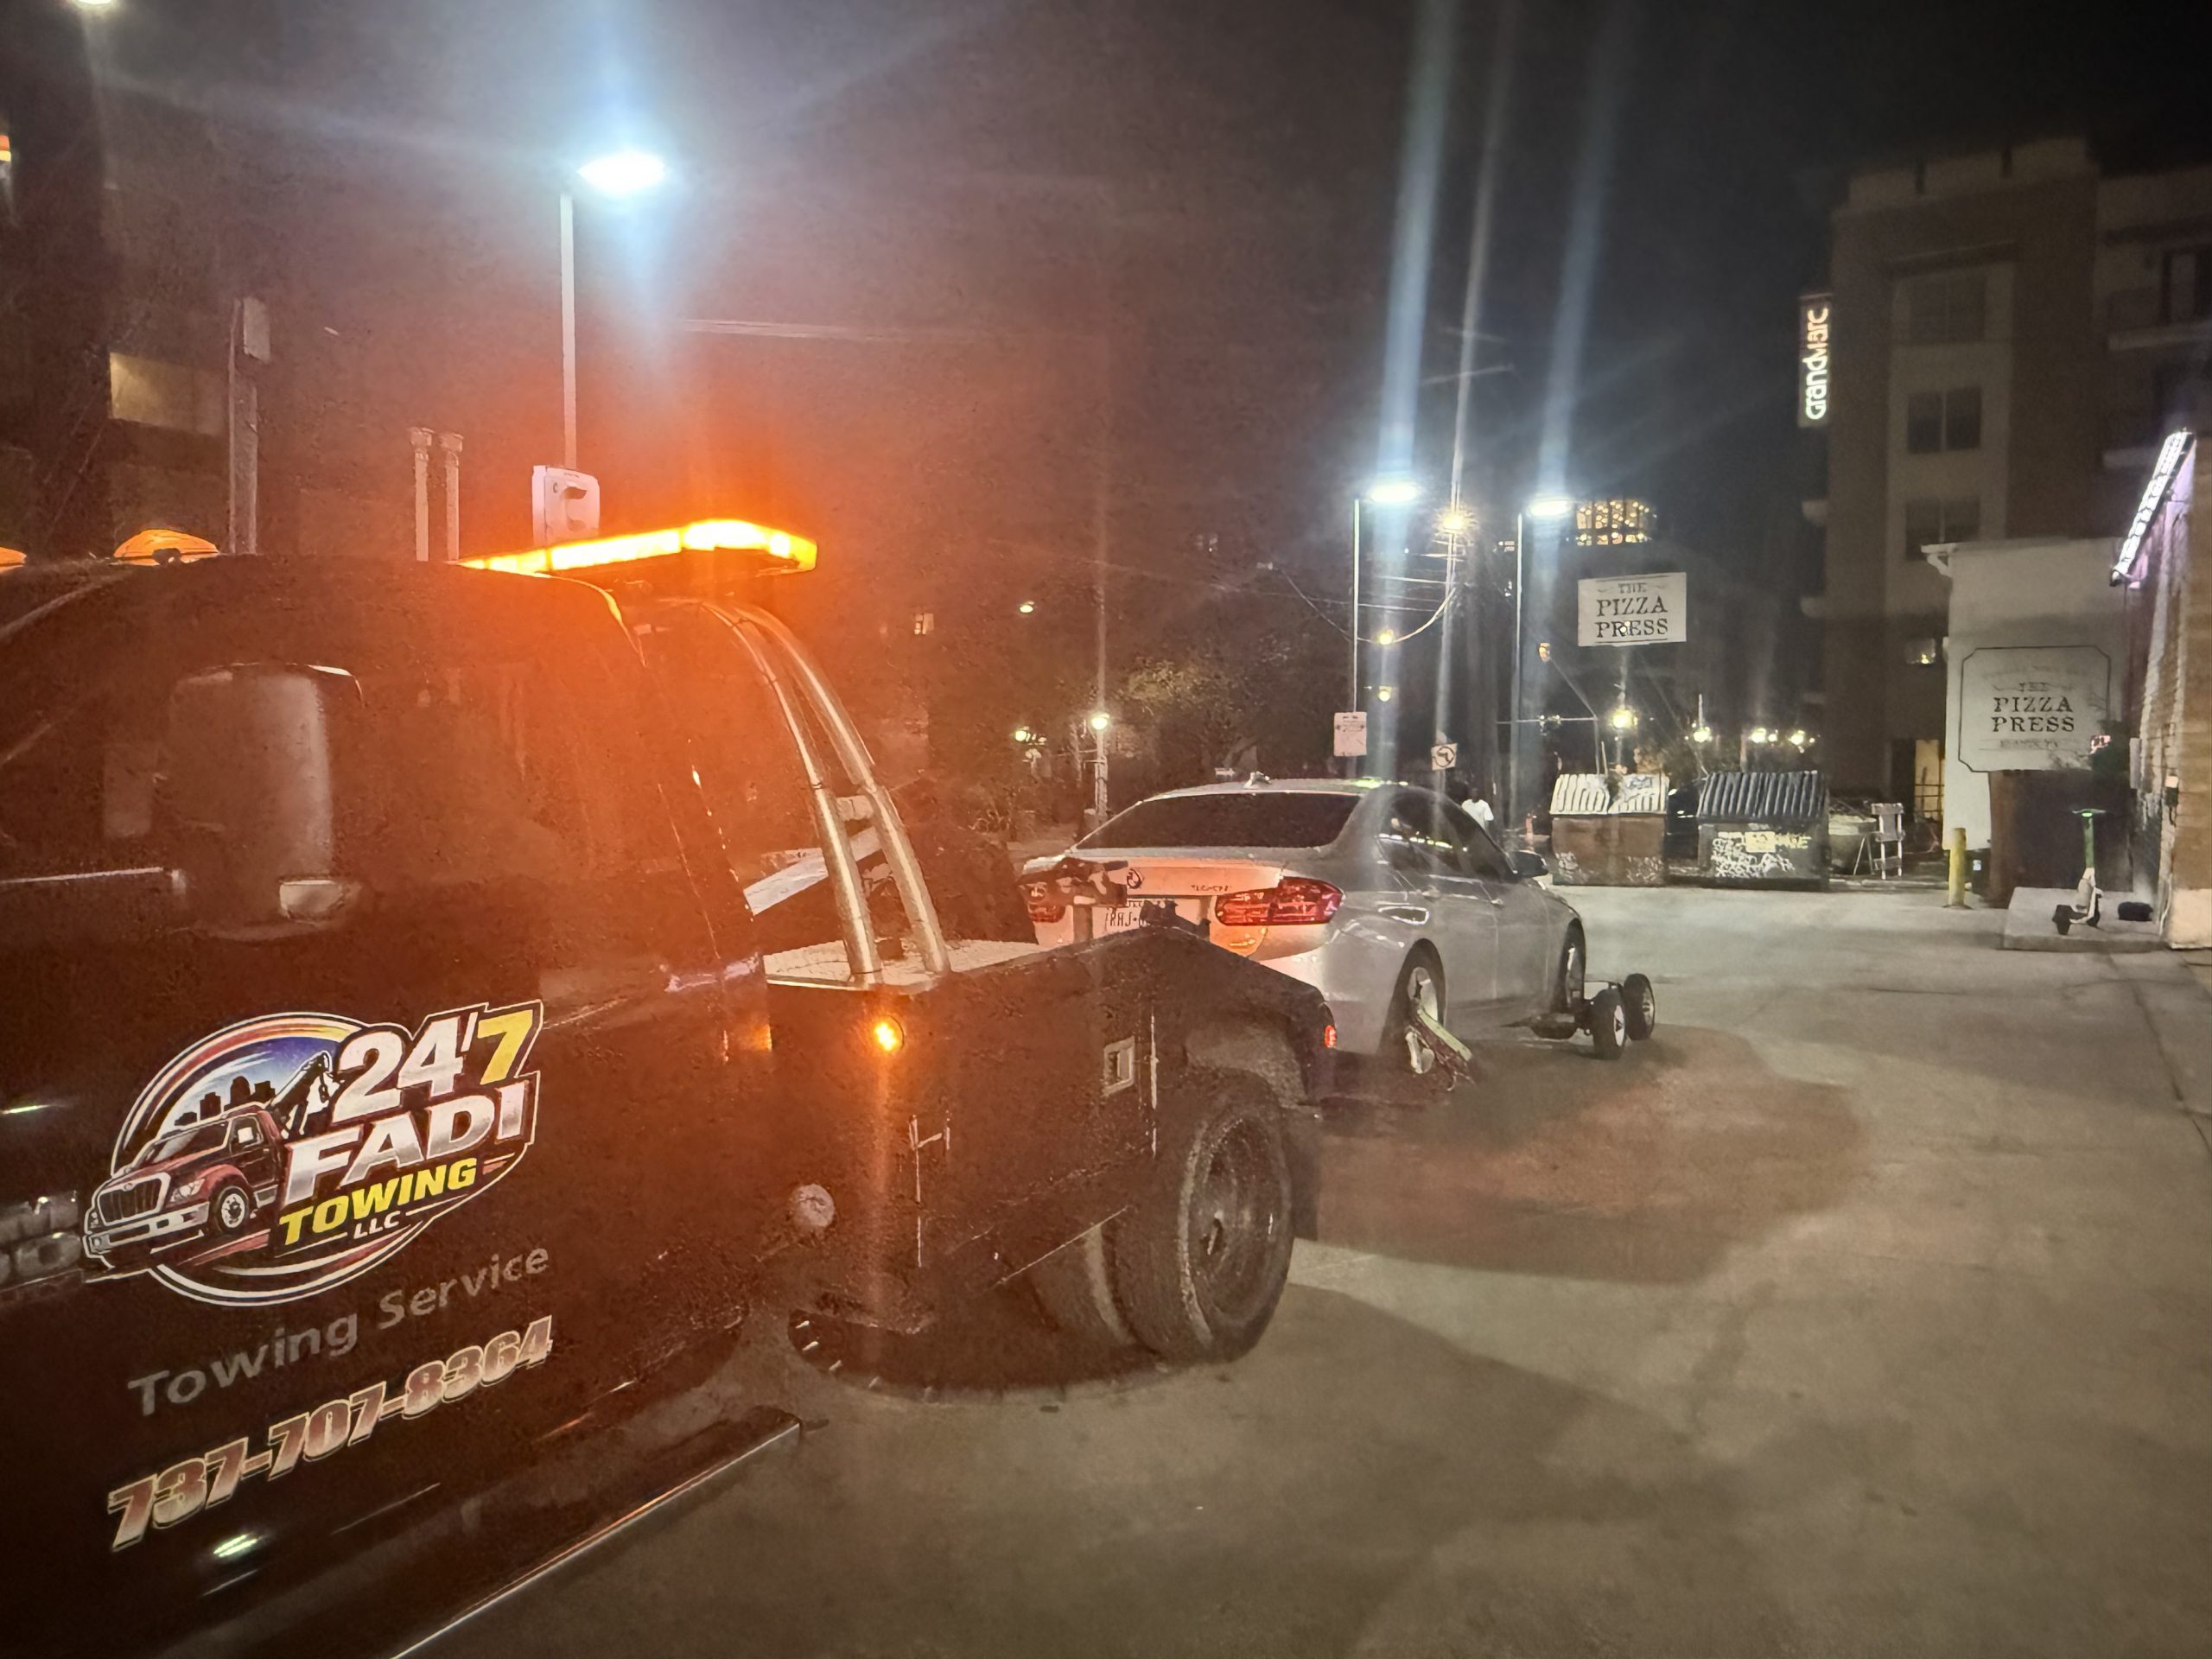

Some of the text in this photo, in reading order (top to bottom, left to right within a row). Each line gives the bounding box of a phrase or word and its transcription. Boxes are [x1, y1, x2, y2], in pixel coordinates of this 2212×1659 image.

[1596, 595, 1669, 617] PIZZA
[1594, 618, 1669, 638] PRESS
[1993, 696, 2074, 713] PIZZA
[1991, 716, 2075, 733] PRESS
[283, 1081, 525, 1208] FADI
[279, 1157, 477, 1245] TOWING
[353, 1211, 401, 1240] LLC
[128, 1247, 550, 1416] Towing Service
[107, 1314, 554, 1552] 737-707-8364
